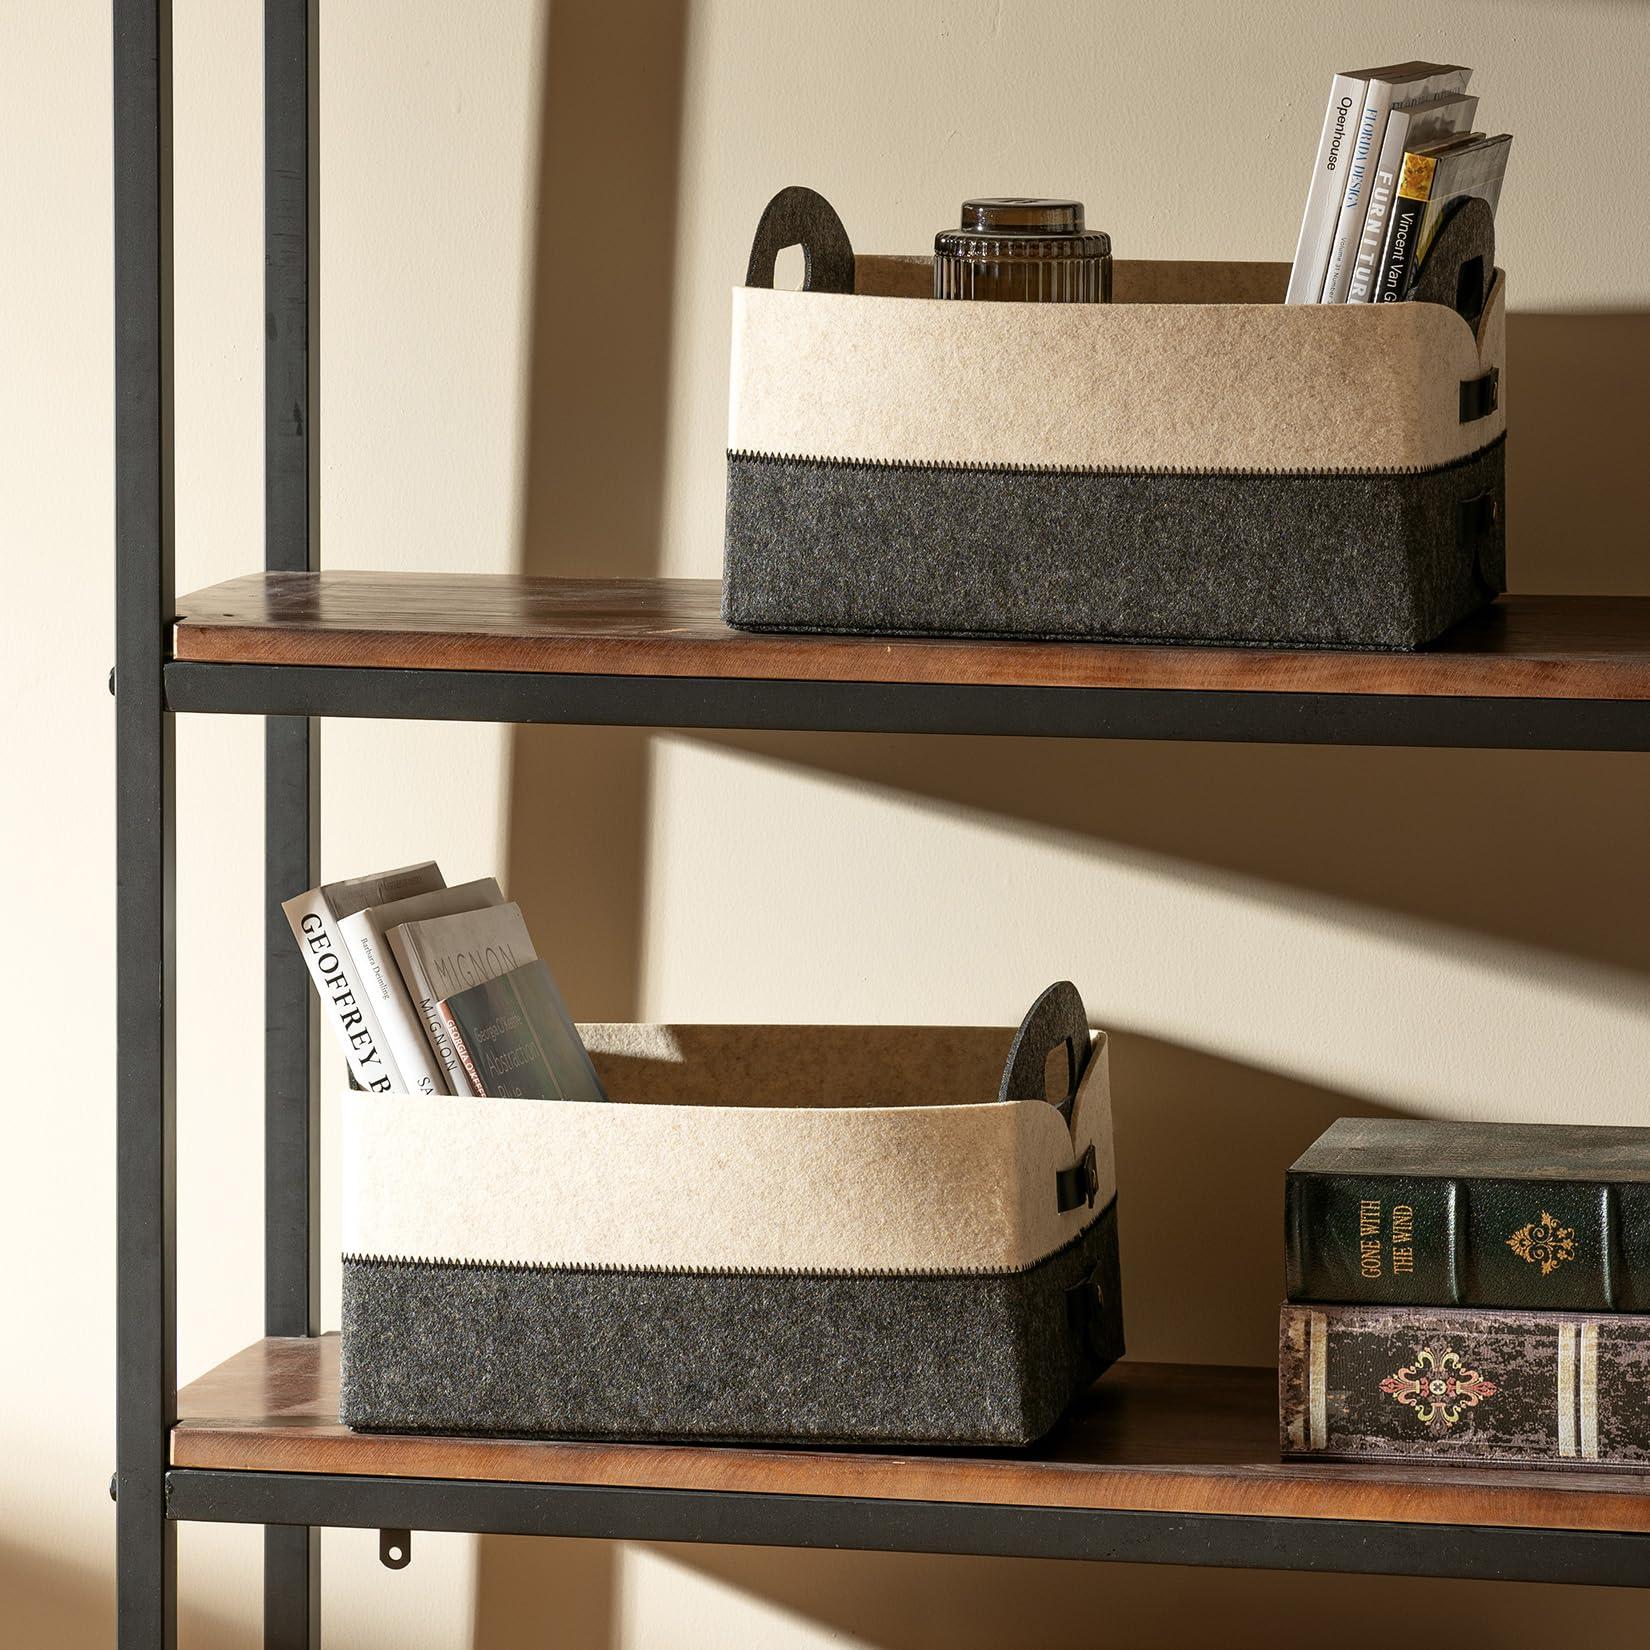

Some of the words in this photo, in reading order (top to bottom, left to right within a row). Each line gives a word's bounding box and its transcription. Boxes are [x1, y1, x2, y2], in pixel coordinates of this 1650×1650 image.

[1327, 96, 1353, 171] Openhouse
[1353, 108, 1378, 164] FLORIDA
[1345, 164, 1368, 208] DESIGN
[1392, 212, 1415, 262] Vincent
[1387, 265, 1403, 288] Van
[360, 937, 376, 966] Barbara
[372, 965, 390, 1000] Deimling
[434, 943, 518, 993] MIGNON
[300, 913, 382, 1068] GEOFFREY
[419, 998, 458, 1072] MIGNON
[446, 1019, 470, 1063] GEORGIA
[486, 1041, 540, 1078] Abstraction
[1360, 1200, 1381, 1236] WITH
[1393, 1204, 1413, 1243] WIND
[1361, 1240, 1382, 1278] GONE
[1393, 1247, 1413, 1274] THE
